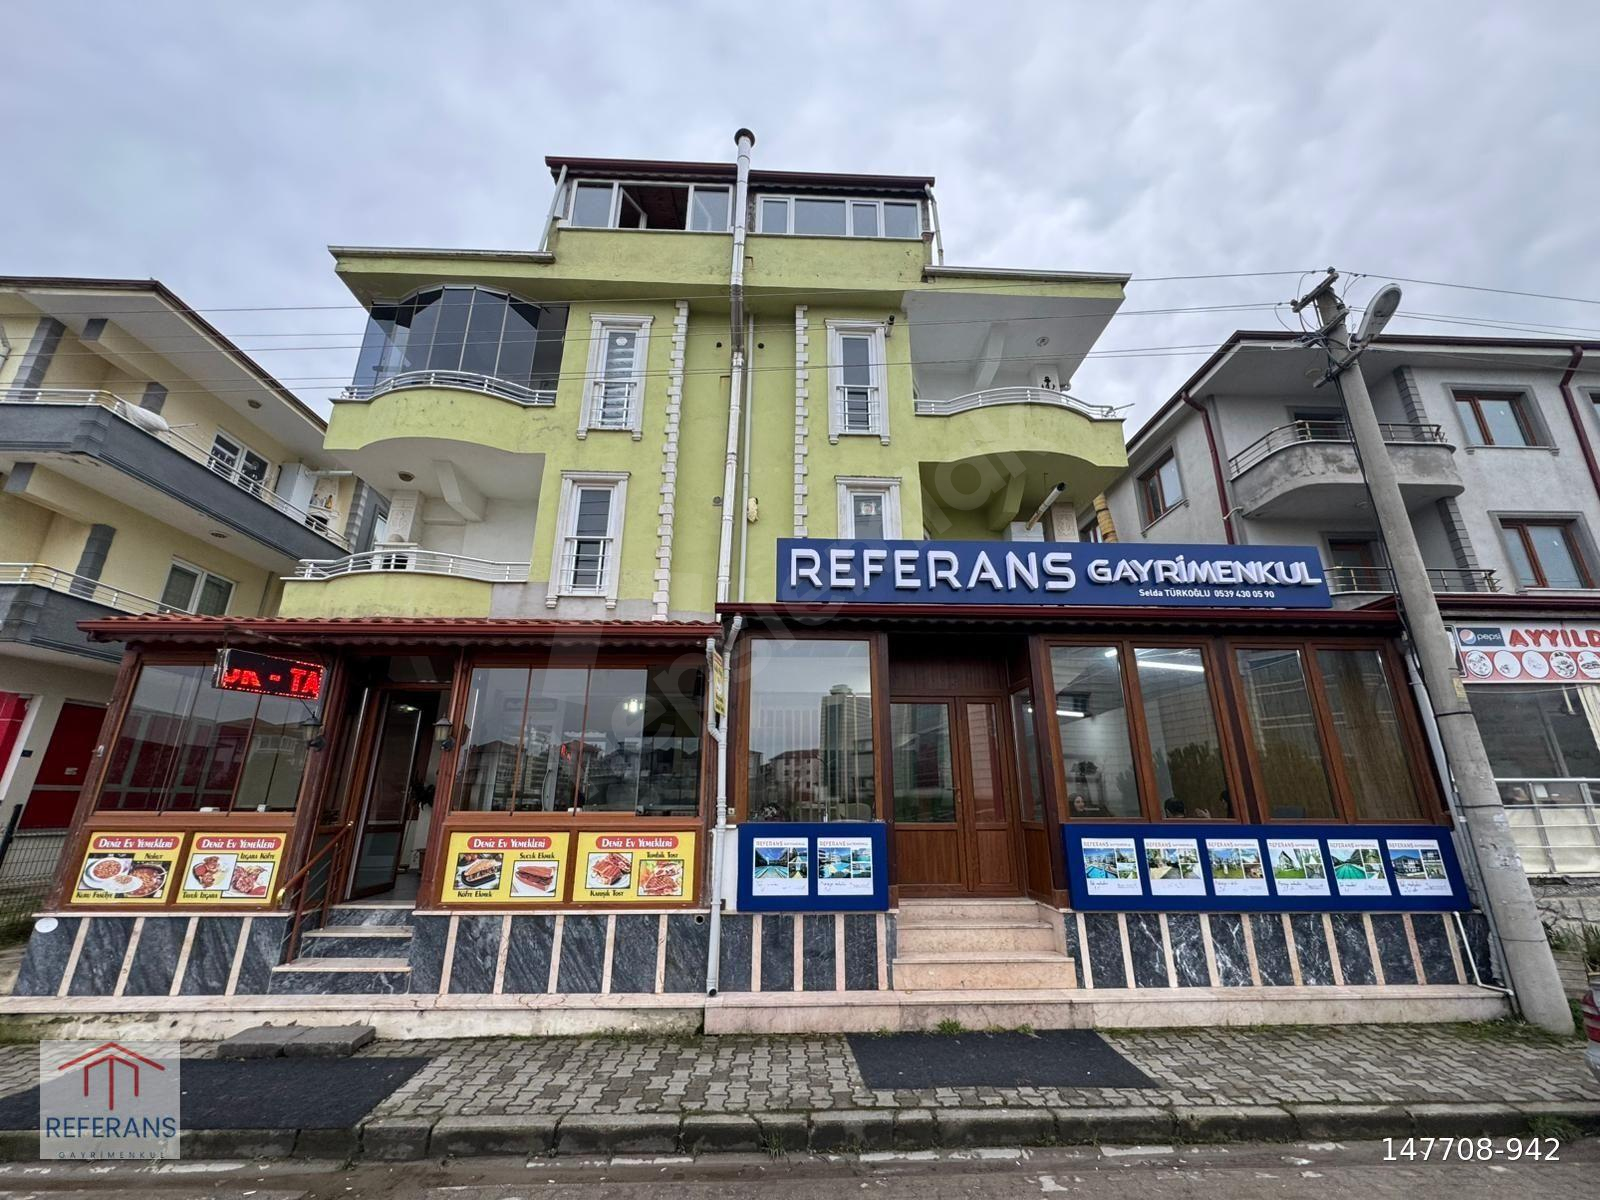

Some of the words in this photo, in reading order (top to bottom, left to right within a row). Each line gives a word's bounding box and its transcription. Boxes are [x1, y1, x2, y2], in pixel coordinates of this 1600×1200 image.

[790, 548, 1077, 591] REFERANS
[1087, 554, 1323, 585] GAYRİMENKUL
[1138, 588, 1163, 598] Selda
[1165, 587, 1211, 598] TÜRKOĞLU
[1214, 589, 1234, 598] 0539
[1235, 590, 1251, 598] 430
[1252, 590, 1264, 598] 05
[1264, 590, 1275, 599] 90
[1476, 632, 1503, 641] pepsi
